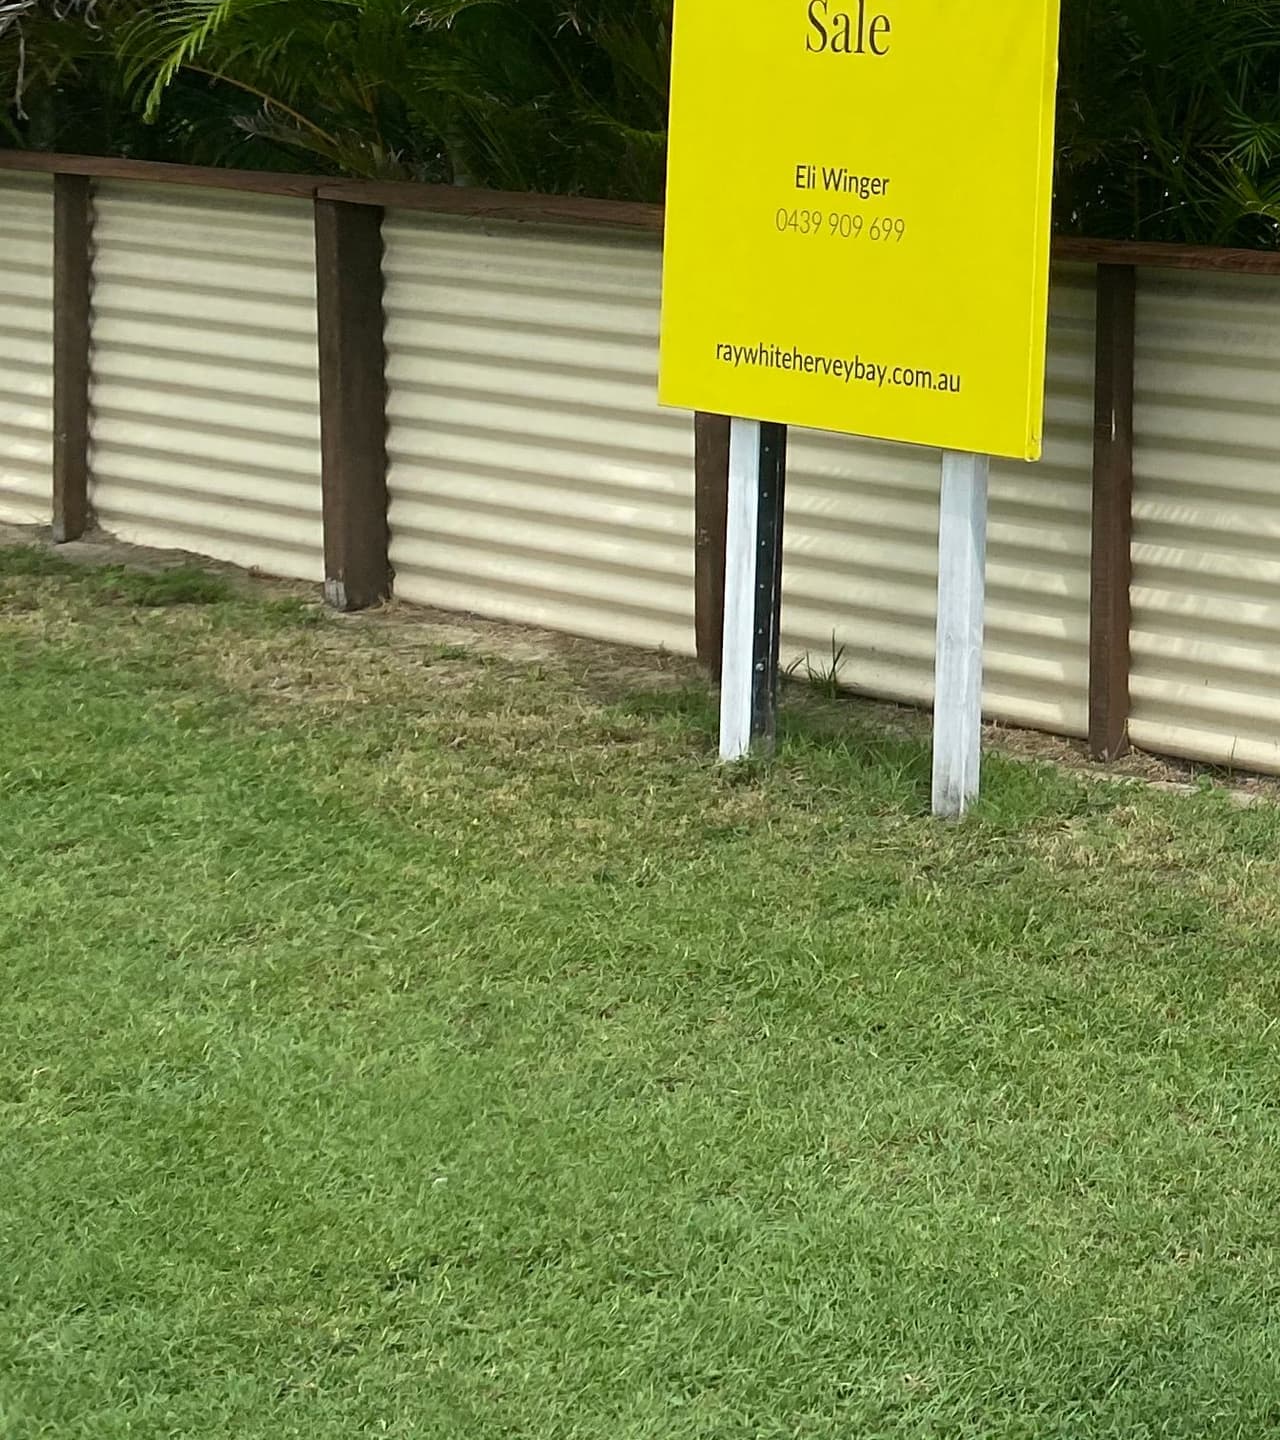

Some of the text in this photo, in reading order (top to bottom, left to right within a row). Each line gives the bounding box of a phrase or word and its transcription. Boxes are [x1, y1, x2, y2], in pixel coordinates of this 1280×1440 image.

[795, 164, 890, 200] Eli Winger
[775, 207, 906, 243] 0439 909 699
[716, 342, 962, 393] raywhiteherveybay.com.au
